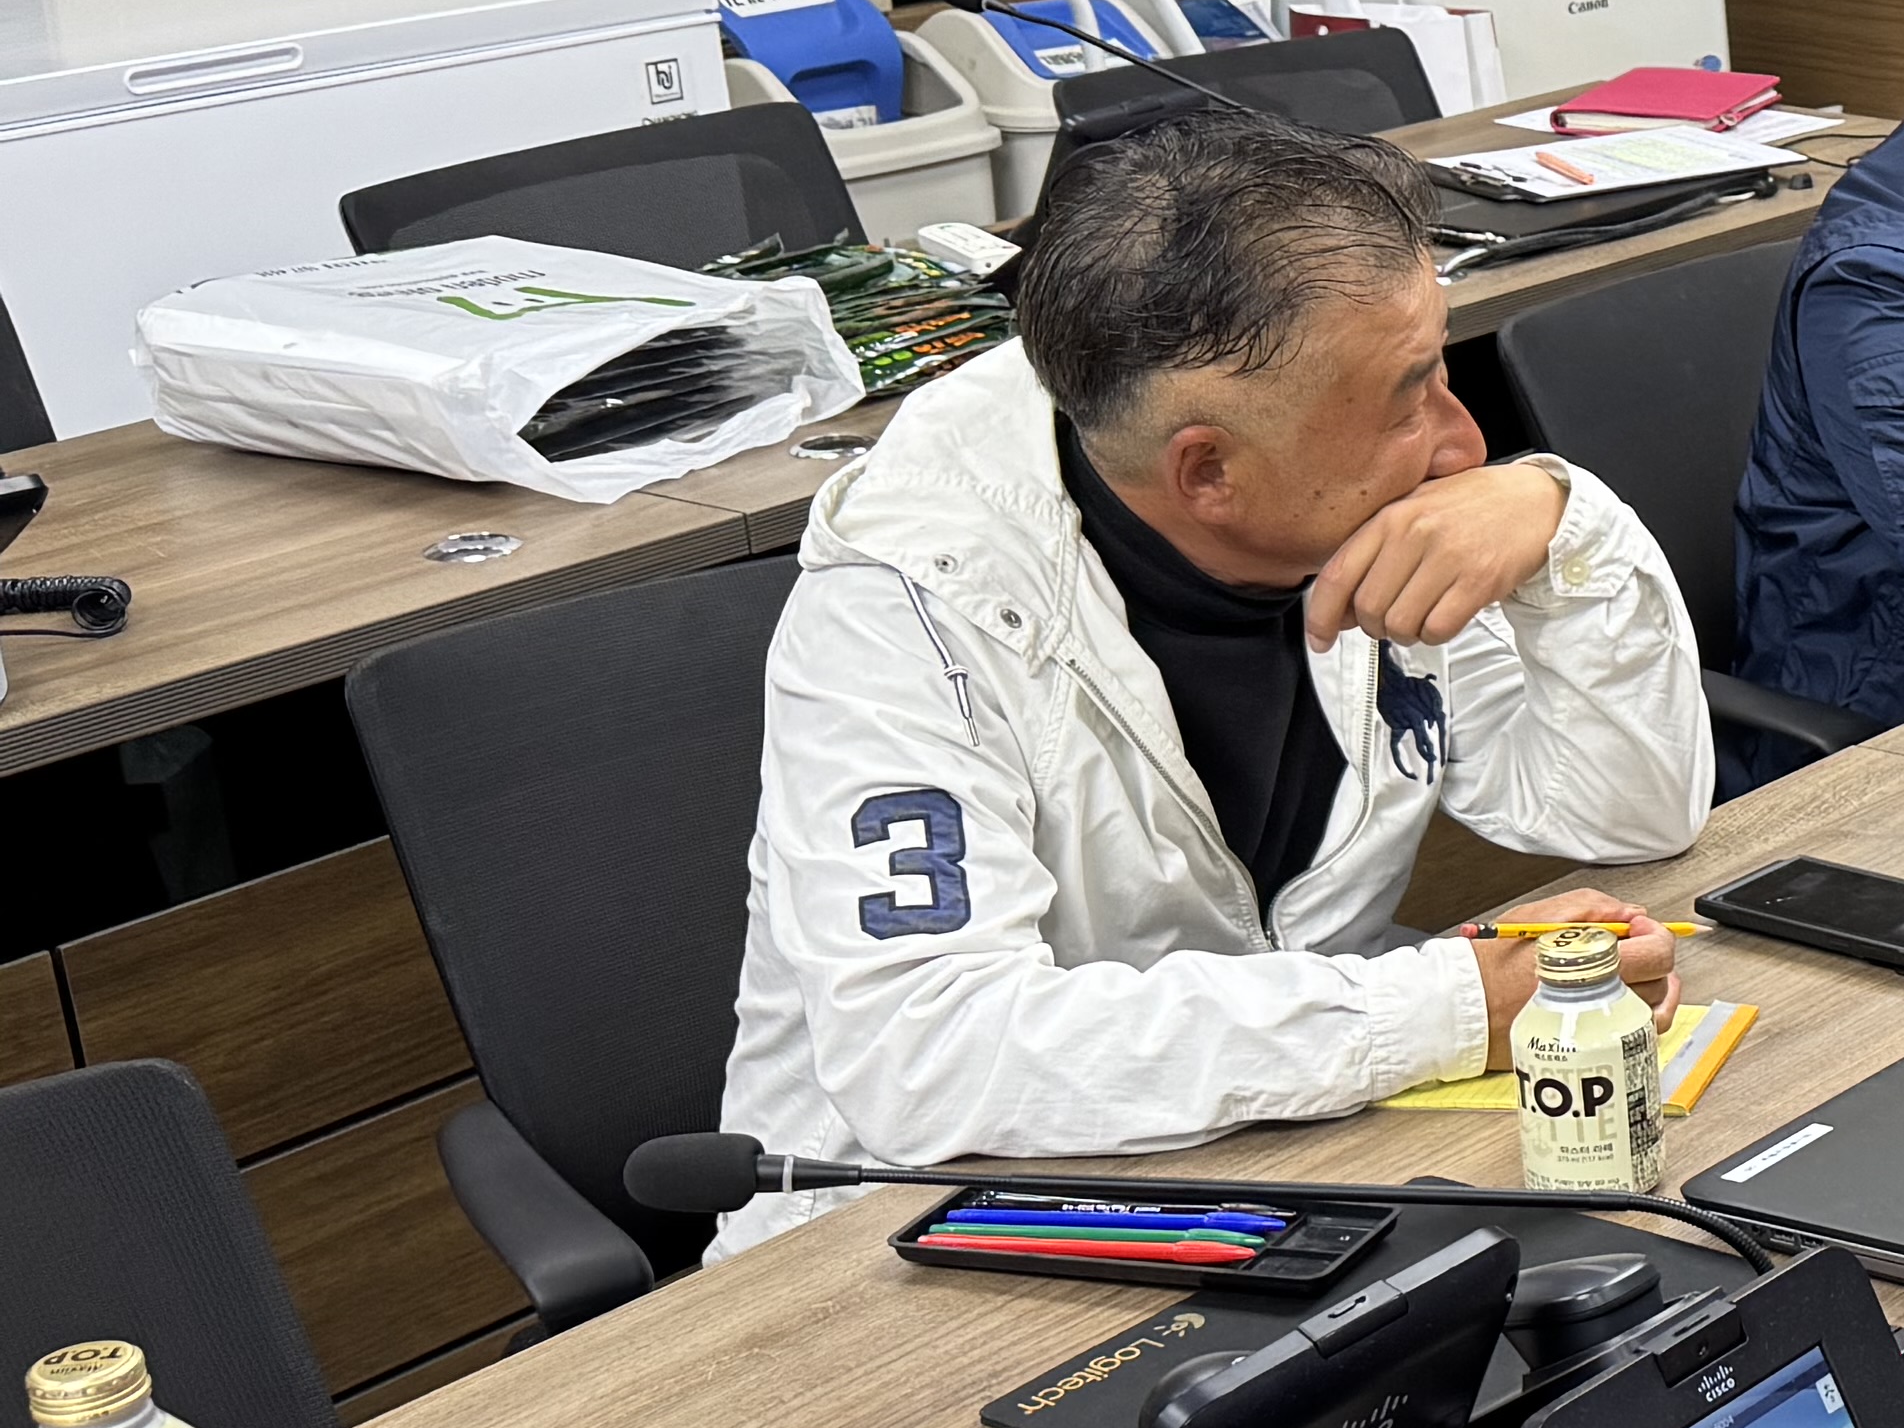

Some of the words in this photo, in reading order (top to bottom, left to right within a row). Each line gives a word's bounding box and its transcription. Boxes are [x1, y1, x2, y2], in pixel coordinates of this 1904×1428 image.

[852, 789, 971, 940] 3
[1527, 1036, 1577, 1053] Maxim
[1516, 1065, 1614, 1118] T.O.P
[1017, 1337, 1164, 1416] Logitech
